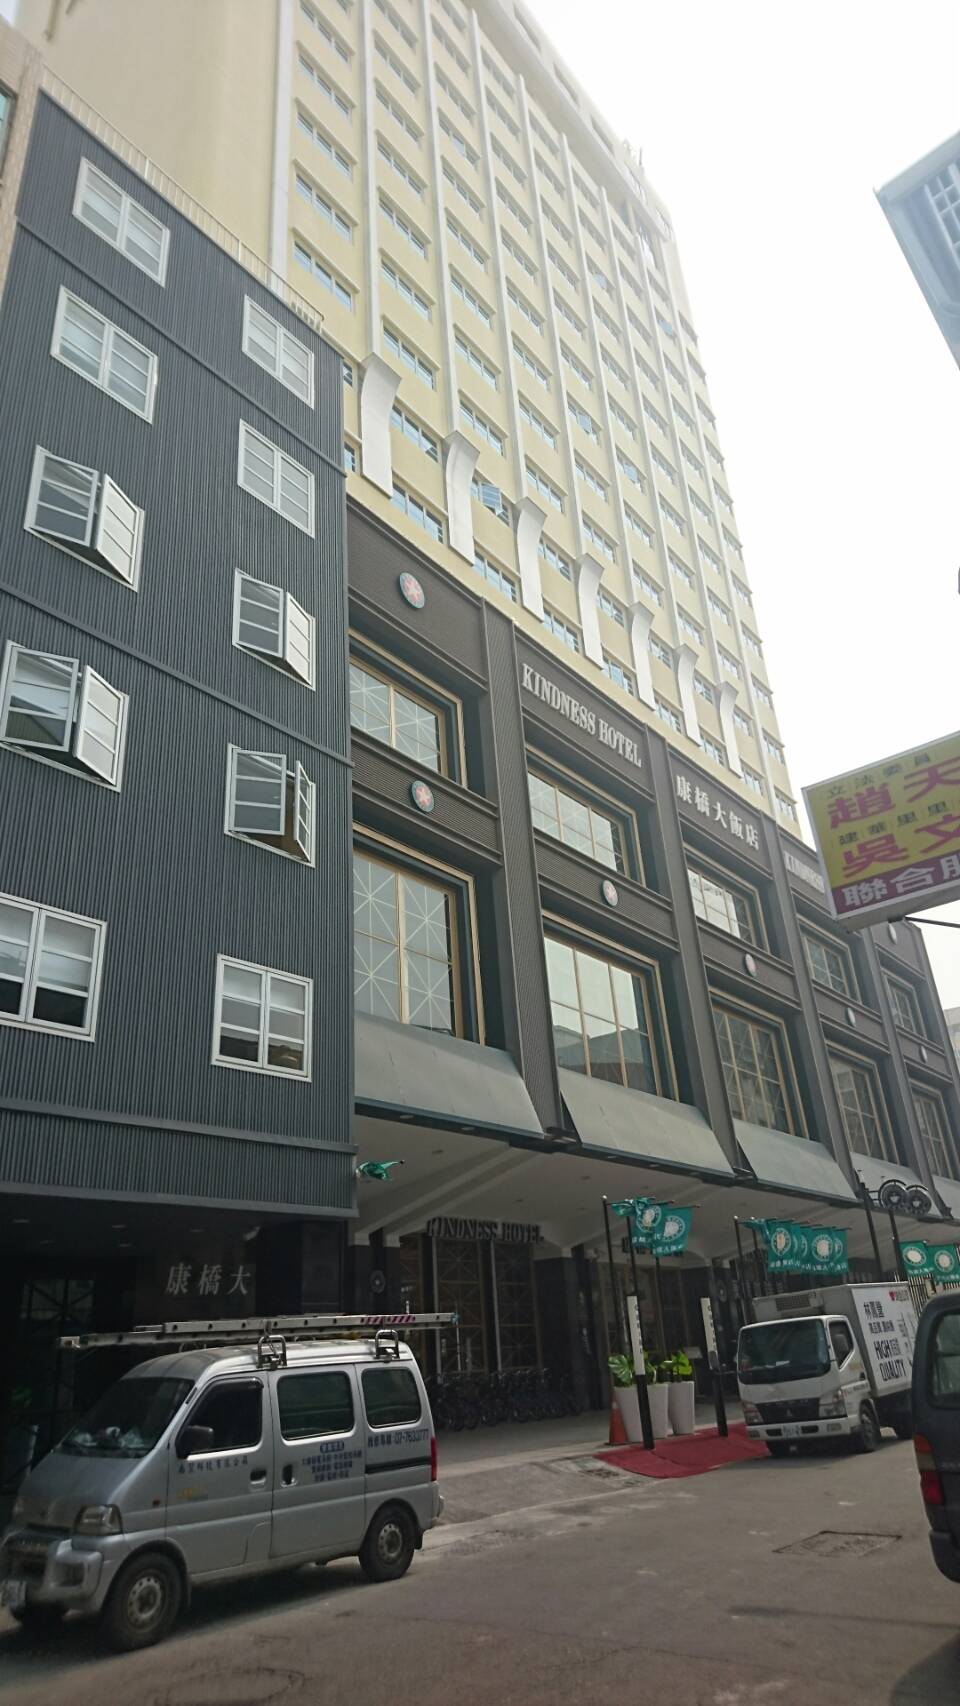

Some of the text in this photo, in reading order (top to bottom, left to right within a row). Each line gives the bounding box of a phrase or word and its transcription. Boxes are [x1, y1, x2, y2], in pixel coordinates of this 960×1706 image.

[521, 663, 642, 768] KINDNESS HOTEL
[675, 774, 759, 851] 康橋大飯店
[427, 1216, 499, 1241] KINDNESS
[165, 1262, 252, 1296] 康橋大
[879, 1359, 907, 1382] QUALITY
